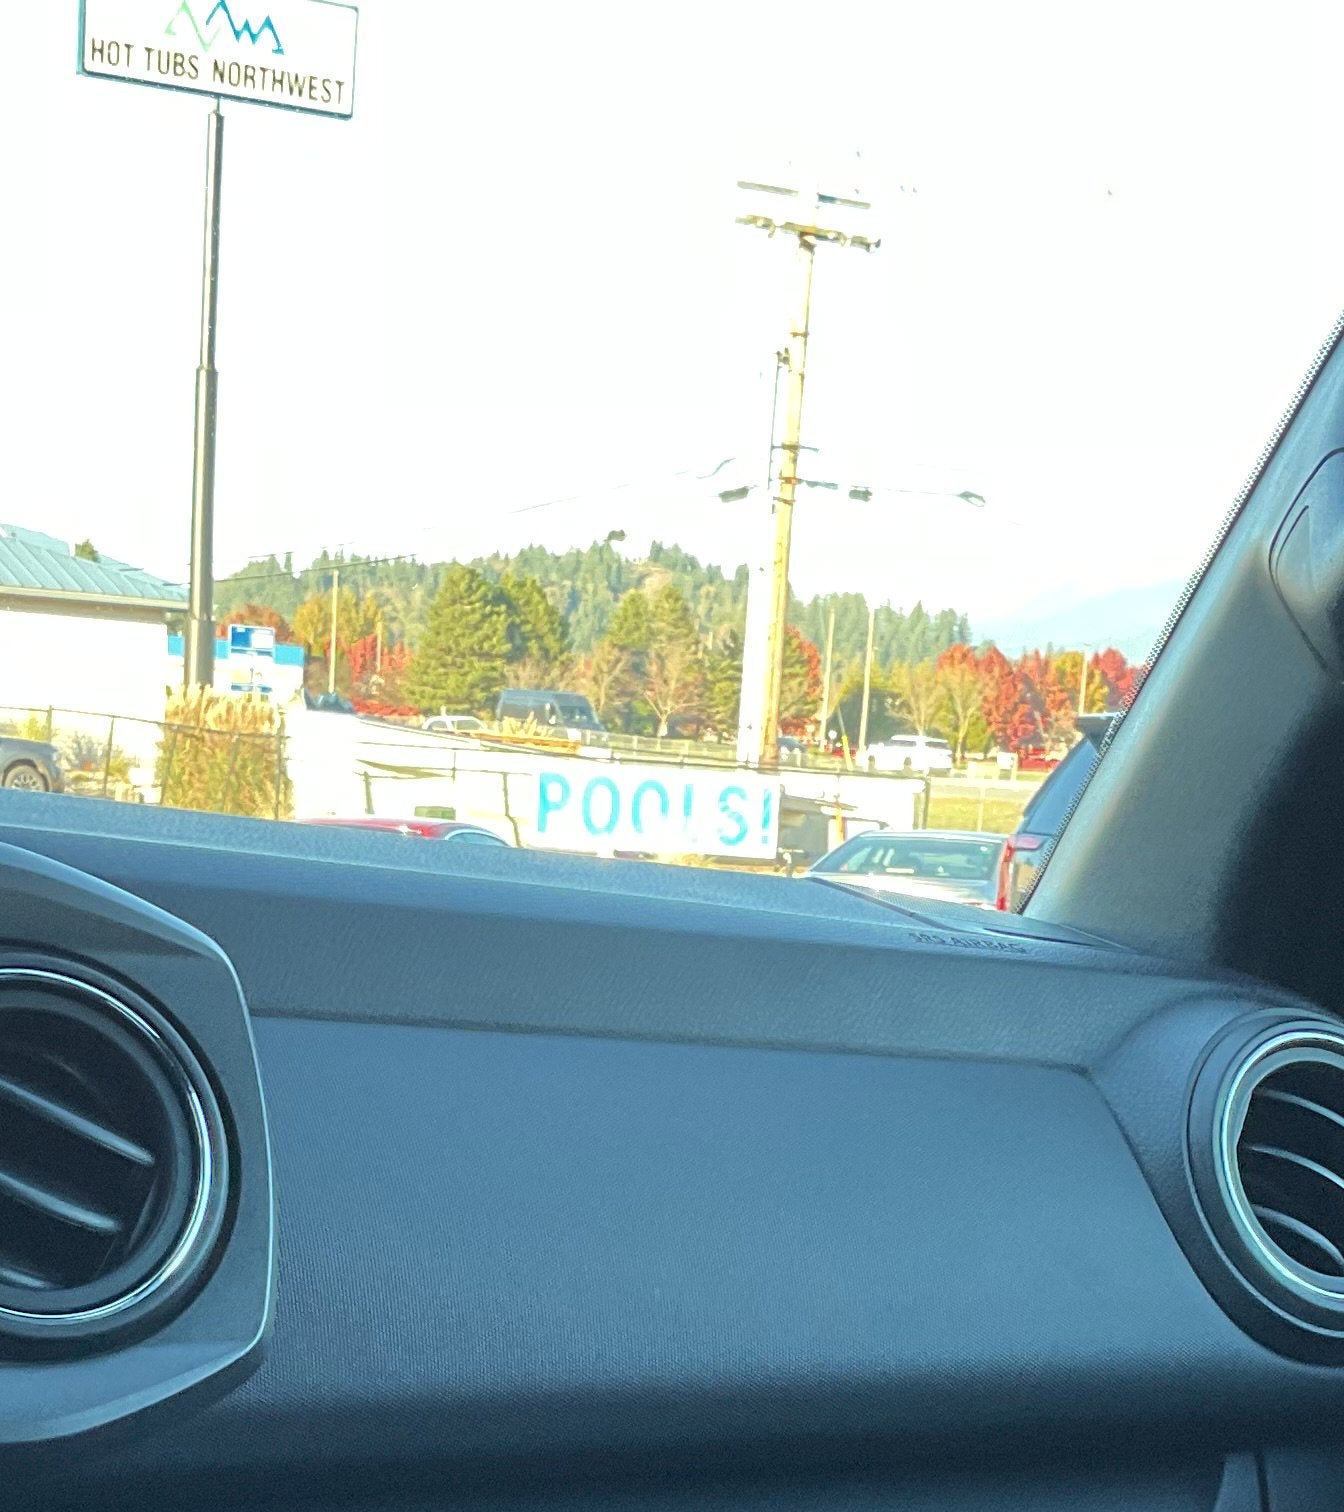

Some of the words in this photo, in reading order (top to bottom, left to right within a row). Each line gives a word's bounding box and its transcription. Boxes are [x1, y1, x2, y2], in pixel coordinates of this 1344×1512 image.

[91, 38, 134, 67] HOT
[145, 47, 200, 80] TUBS
[213, 59, 346, 105] NORTHWEST
